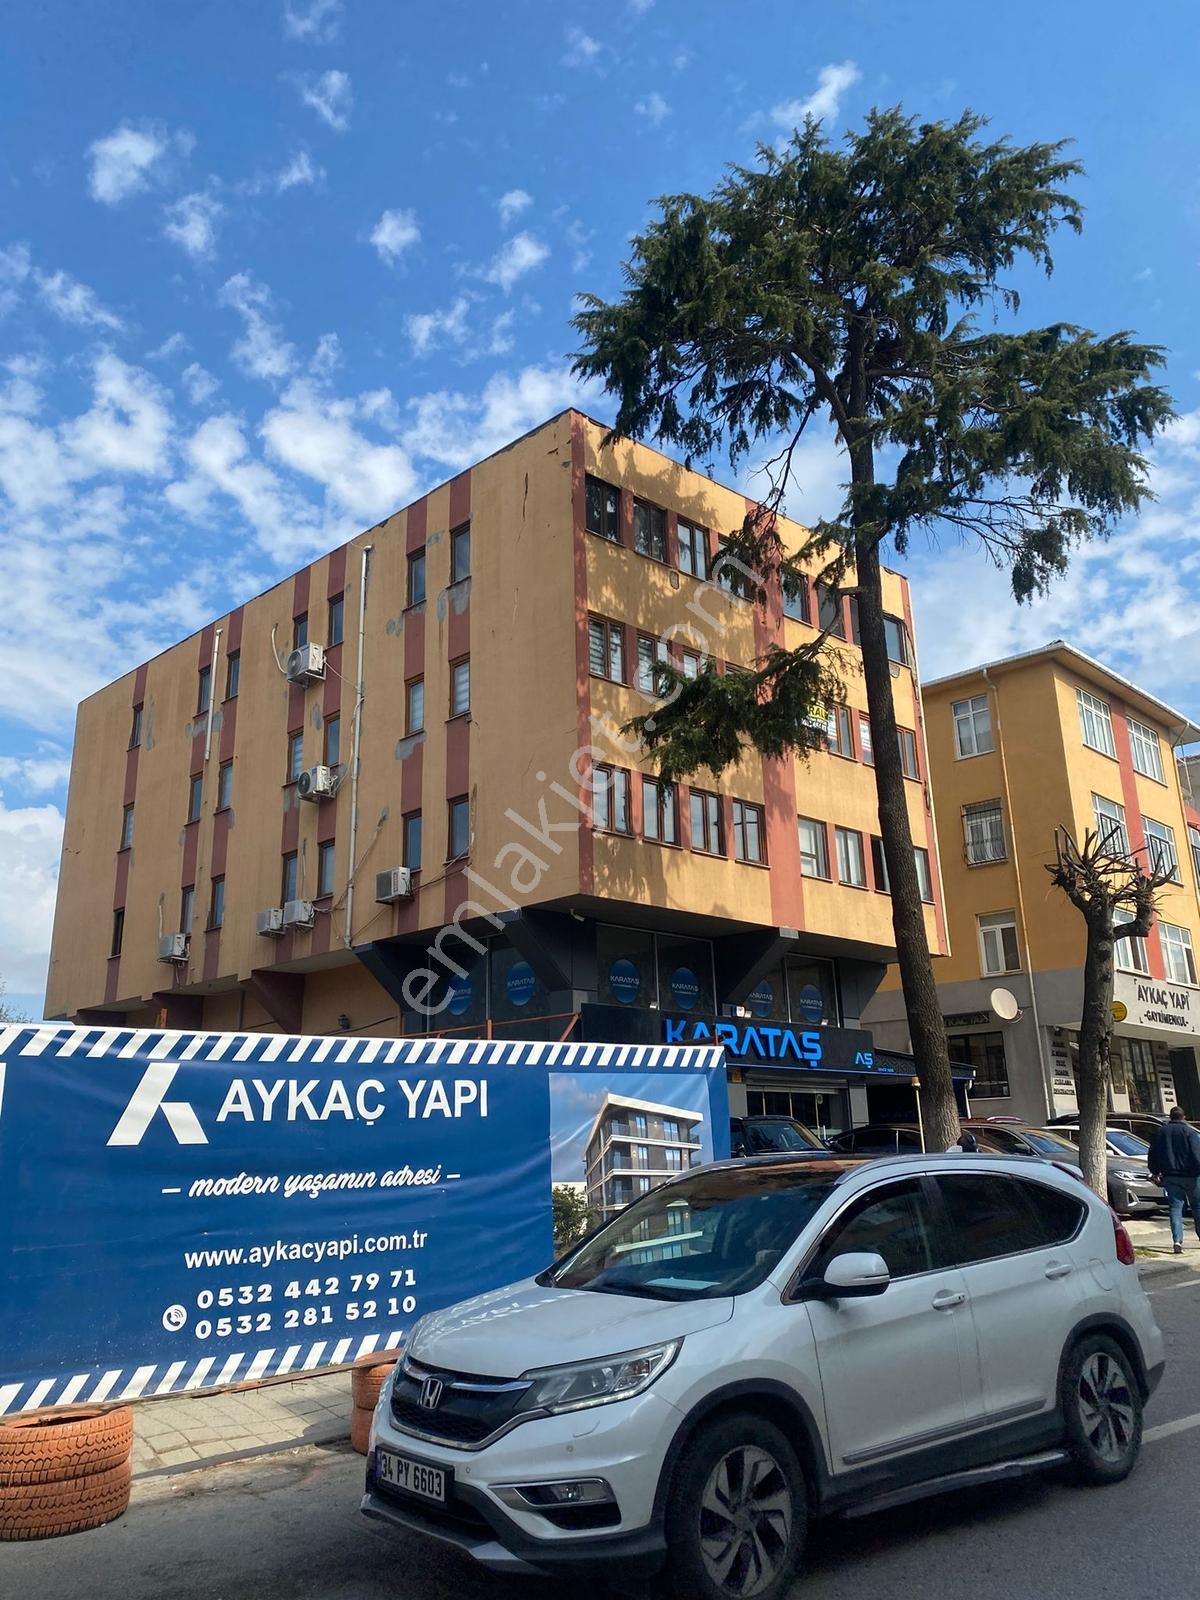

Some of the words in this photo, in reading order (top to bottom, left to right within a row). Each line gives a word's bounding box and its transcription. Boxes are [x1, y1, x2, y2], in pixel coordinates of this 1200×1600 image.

[1138, 985, 1168, 1009] AYKAÇ
[665, 1018, 822, 1068] KARATAŞ
[855, 1052, 874, 1068] AŞ
[216, 1079, 386, 1125] AYKAÇ
[397, 1079, 488, 1118] YAPI
[188, 1171, 280, 1198] modern
[283, 1170, 377, 1198] yaşamın
[379, 1164, 442, 1188] adresi
[184, 1230, 428, 1269] www.aykacyapi.com.tr
[196, 1284, 273, 1309] 0532
[284, 1277, 339, 1299] 442
[350, 1273, 380, 1292] 79
[390, 1269, 416, 1288] 71
[195, 1313, 272, 1340] 0532
[283, 1306, 333, 1328] 281
[345, 1301, 377, 1320] 52
[388, 1295, 416, 1316] 10
[381, 1453, 393, 1480] 34
[397, 1459, 410, 1486] PY
[413, 1465, 442, 1497] 6603
